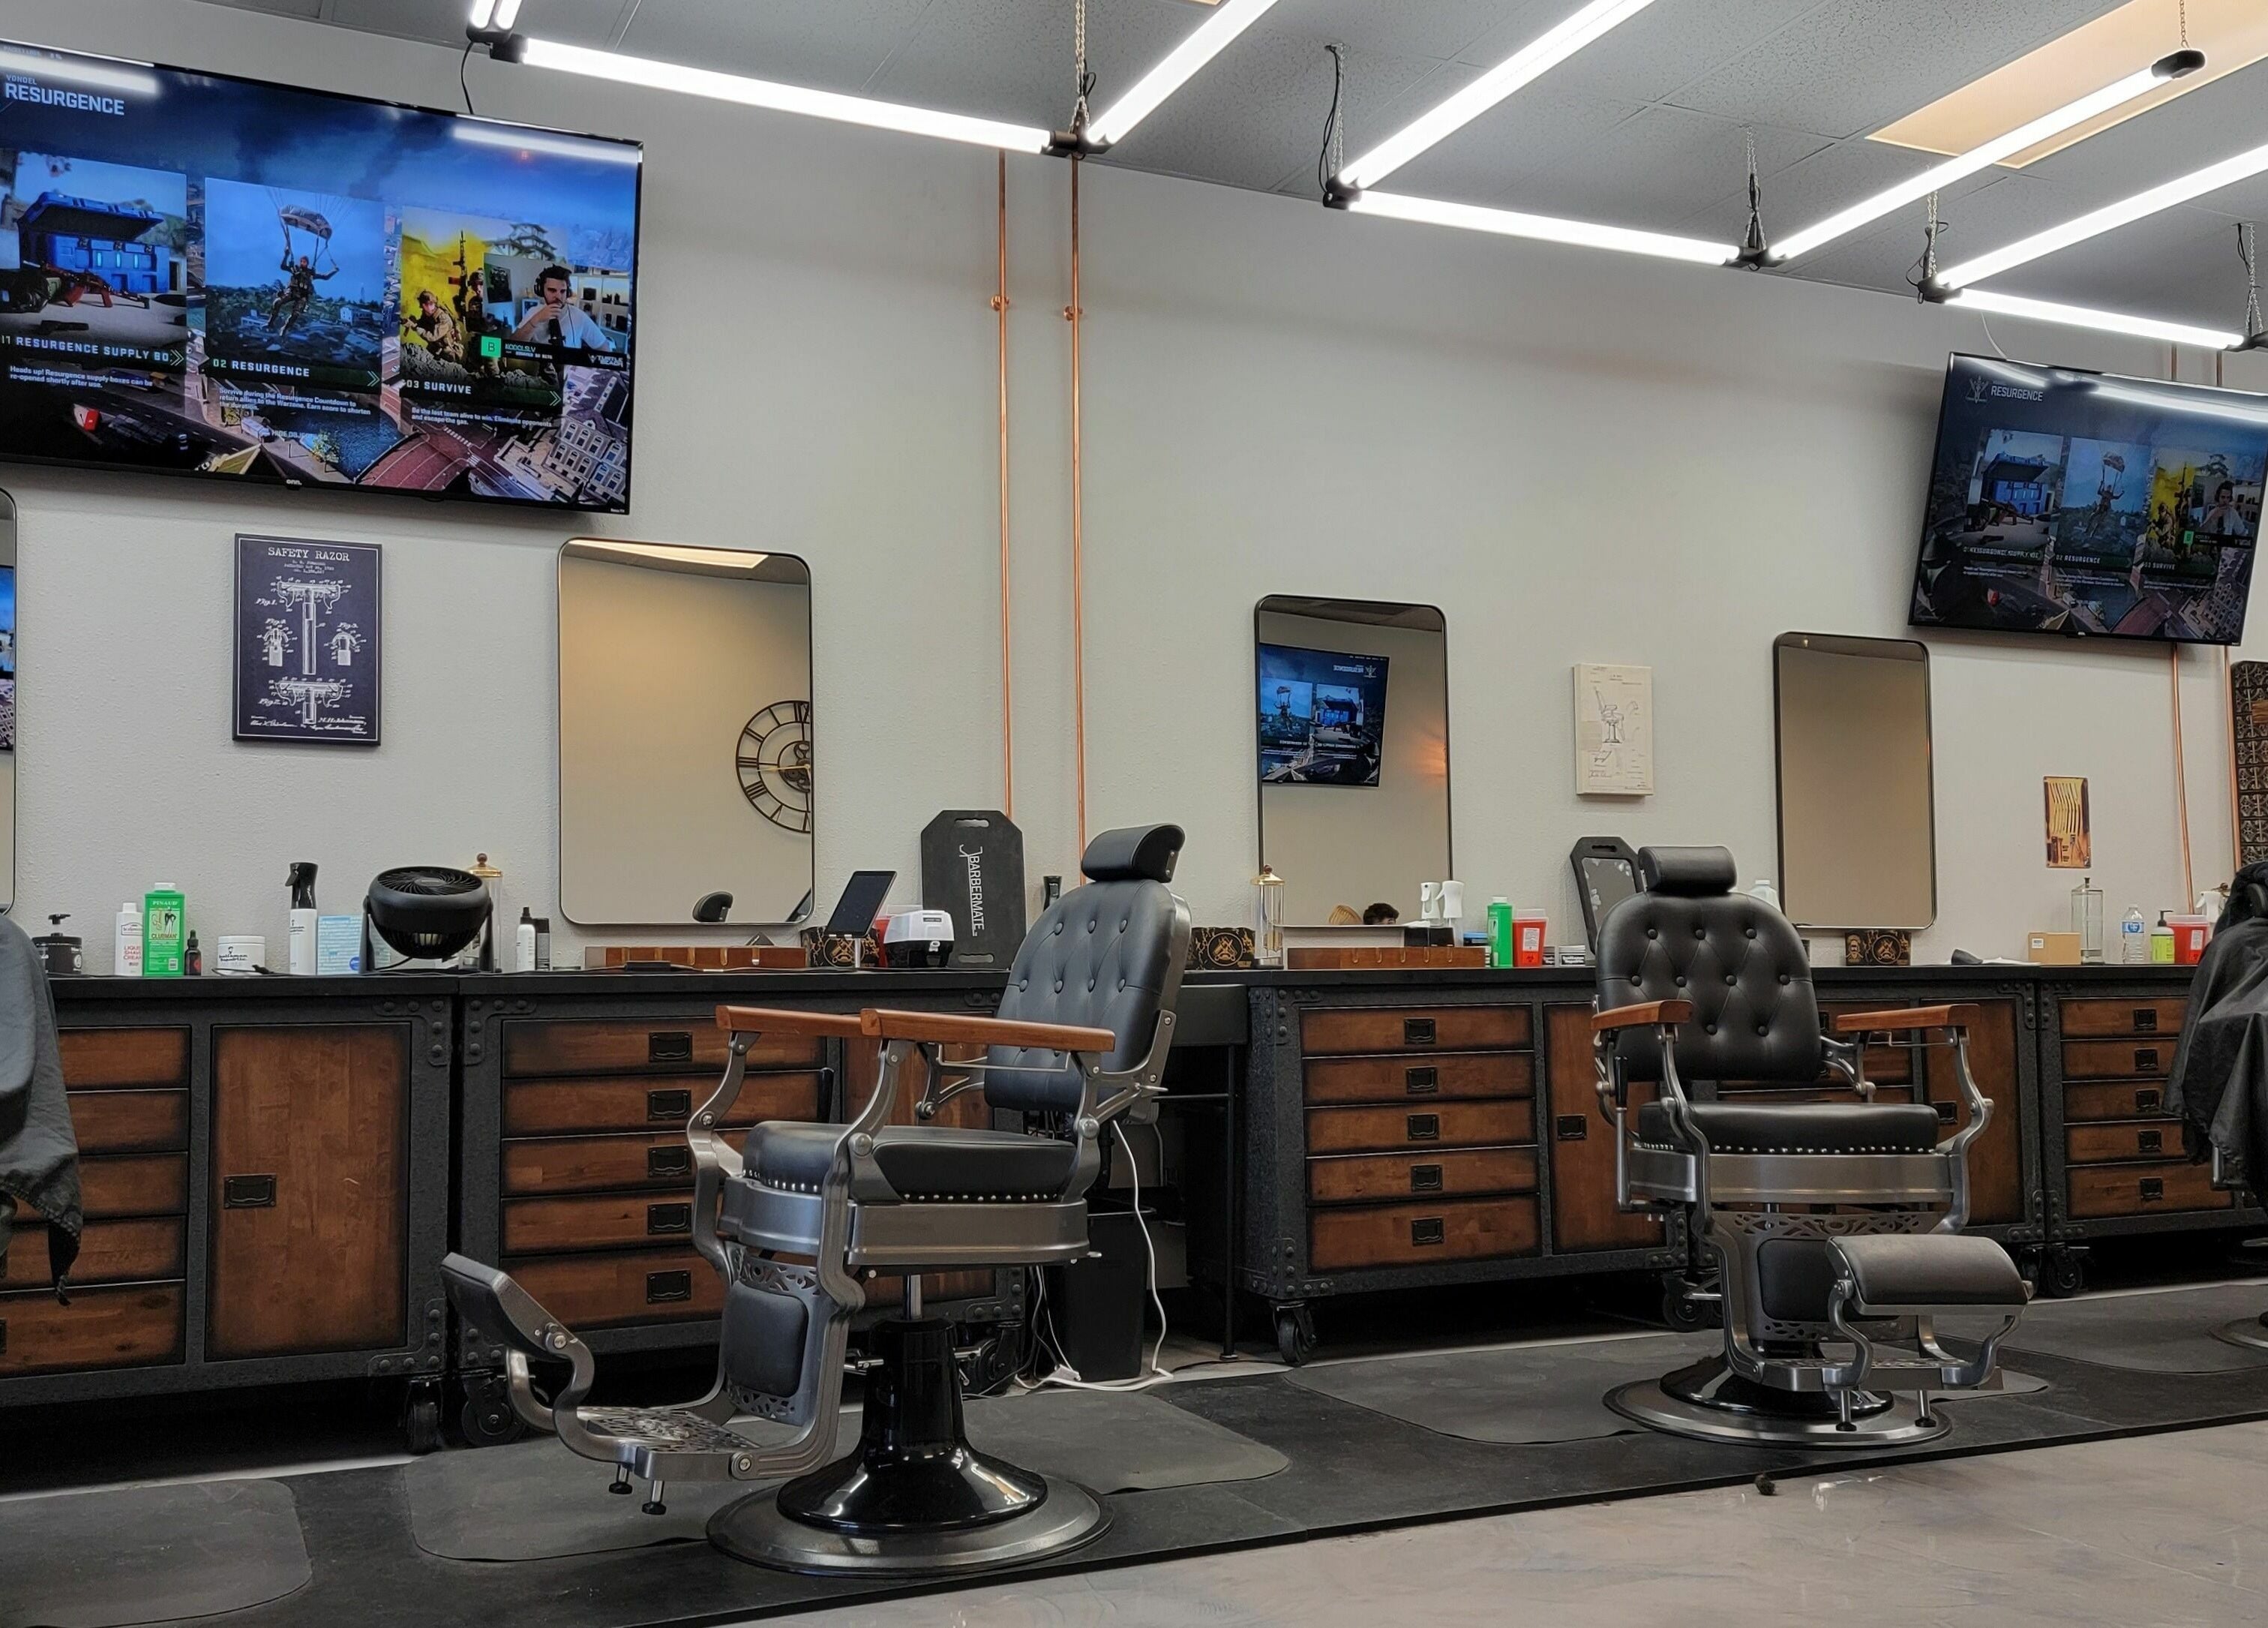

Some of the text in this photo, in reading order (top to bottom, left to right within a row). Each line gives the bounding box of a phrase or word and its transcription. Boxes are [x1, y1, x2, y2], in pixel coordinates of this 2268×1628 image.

[5, 83, 124, 116] RESURGENCE
[16, 336, 99, 354] RESURGENCE
[104, 346, 149, 359] SUPPLY
[488, 342, 495, 352] B
[10, 365, 32, 374] Heads
[45, 369, 86, 380] Resurgence
[86, 374, 109, 383] supply
[110, 375, 130, 384] boxes
[213, 358, 310, 377] 02 RESURGENCE
[46, 377, 70, 386] shortly
[406, 379, 472, 395] 03 SURVIVE
[244, 390, 264, 399] during
[277, 392, 314, 402] Resurgence
[314, 397, 349, 406] Countdown
[1990, 385, 2044, 402] RESURGENCE
[307, 402, 321, 410] Earn
[424, 416, 445, 424] escape
[268, 546, 350, 562] SAFETY RAZOR
[2064, 554, 2101, 564] RESURGENCE
[969, 855, 985, 930] BARBERMATE
